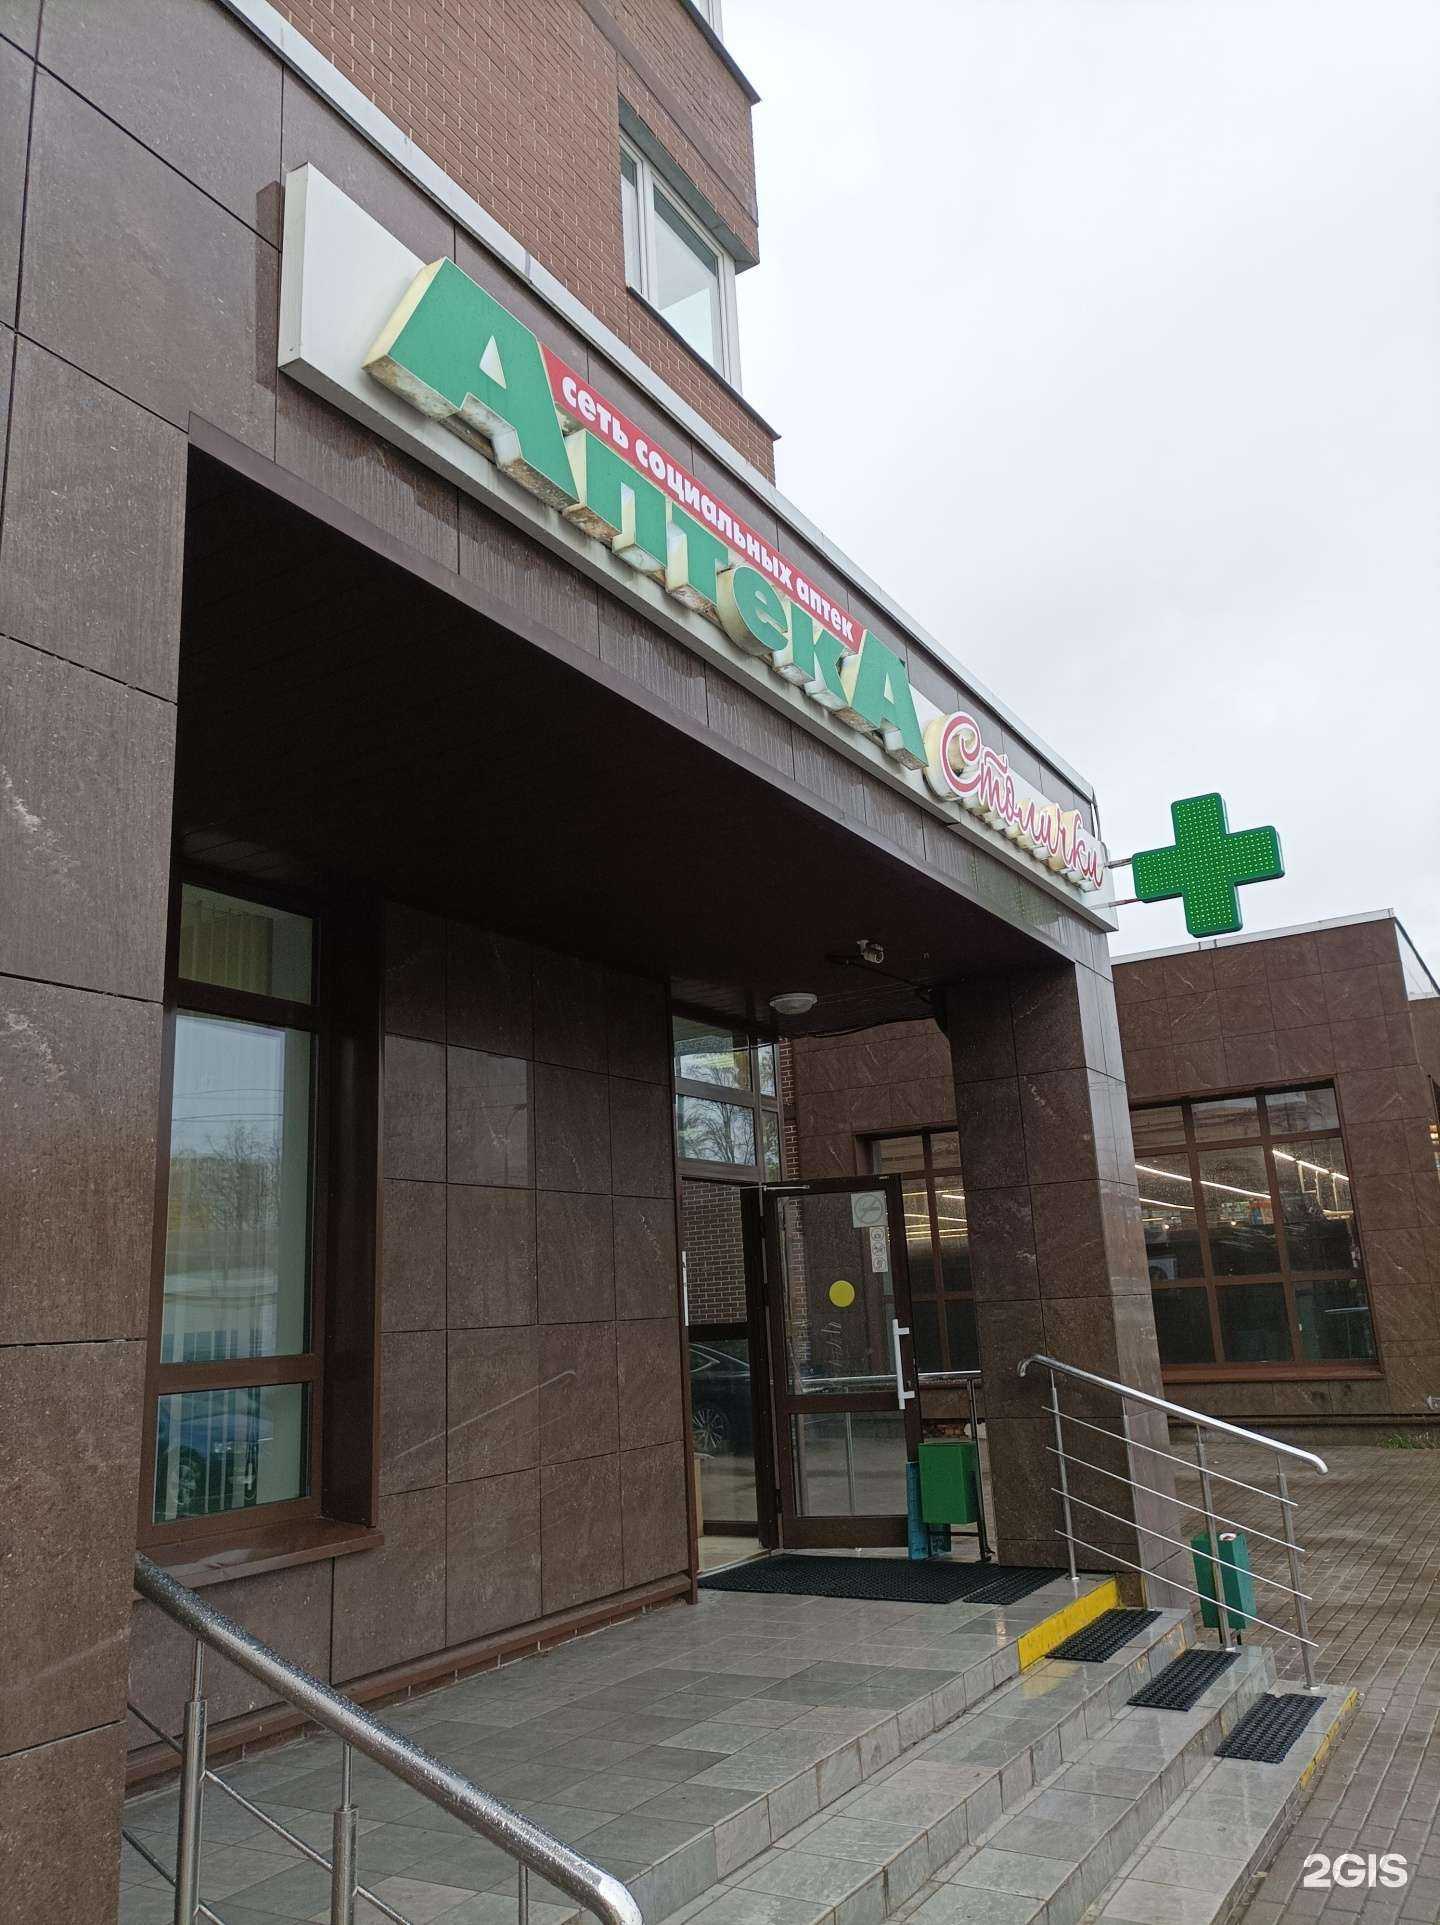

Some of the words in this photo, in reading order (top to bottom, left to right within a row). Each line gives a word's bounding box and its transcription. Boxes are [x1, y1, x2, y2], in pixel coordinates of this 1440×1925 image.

[561, 376, 630, 450] сеть
[634, 438, 795, 592] социальных
[795, 575, 854, 643] аптек
[940, 711, 1106, 889] Столички
